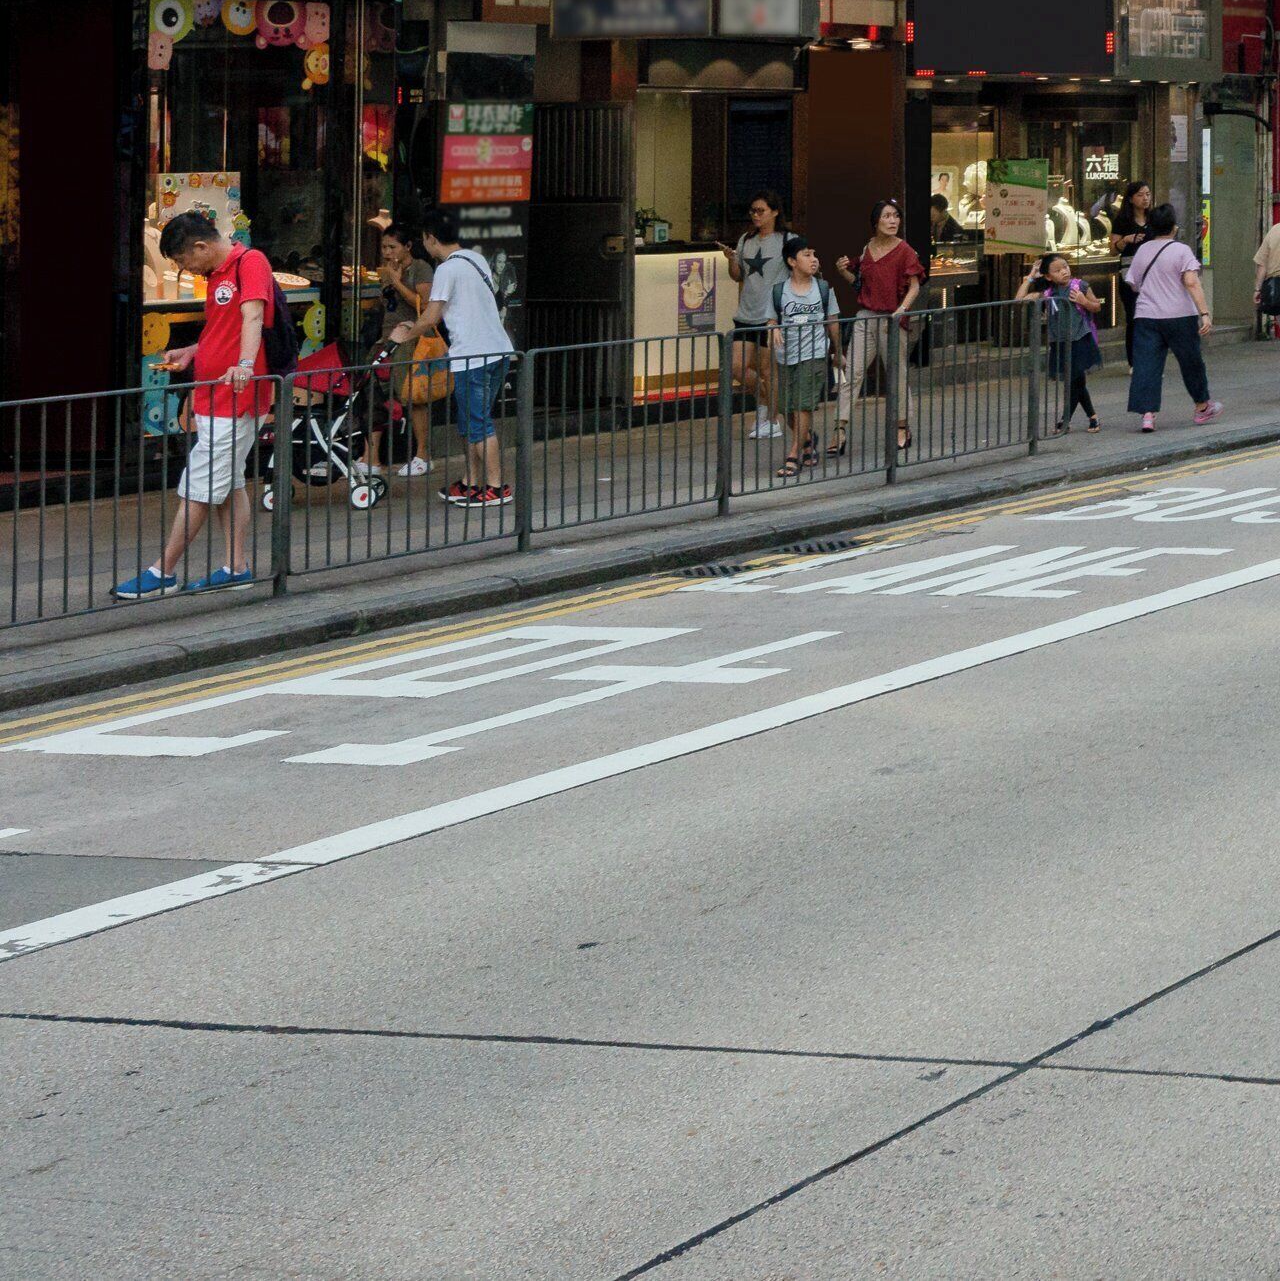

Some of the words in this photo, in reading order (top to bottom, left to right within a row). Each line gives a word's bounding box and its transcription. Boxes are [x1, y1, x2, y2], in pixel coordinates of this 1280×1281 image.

[1086, 154, 1119, 172] 六福
[1085, 172, 1119, 180] LUKFOOK
[668, 543, 1235, 598] LANE
